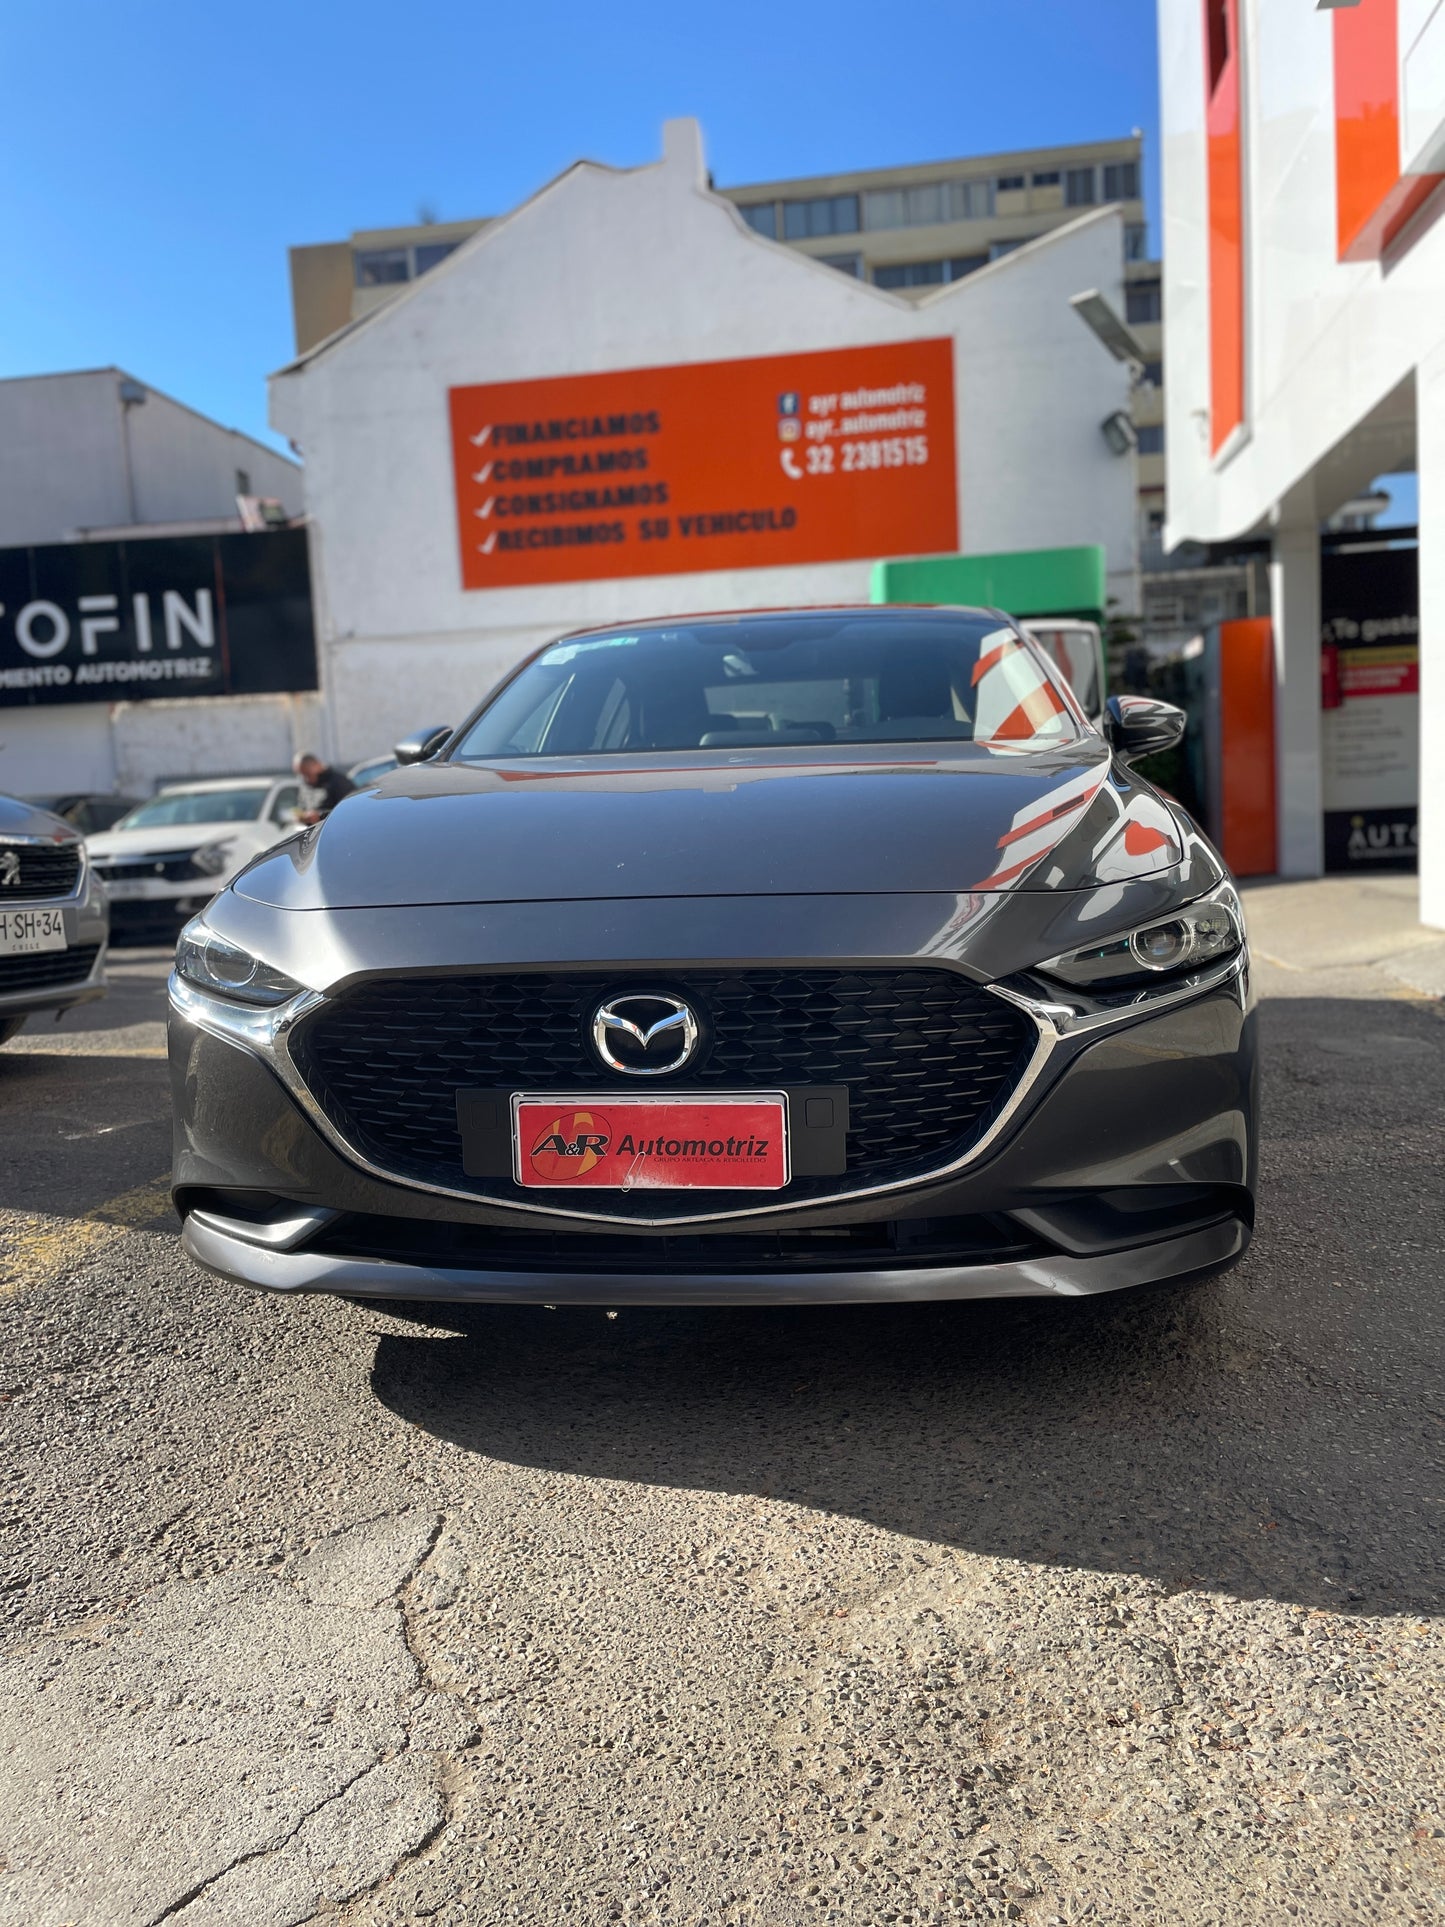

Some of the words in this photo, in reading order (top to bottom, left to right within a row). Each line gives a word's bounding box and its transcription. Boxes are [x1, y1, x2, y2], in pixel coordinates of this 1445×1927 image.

[808, 393, 837, 417] ayr
[840, 382, 925, 410] automotriz
[492, 411, 660, 447] FINANCIAMOS
[493, 449, 649, 482] COMPRAMOS
[806, 445, 834, 474] 32
[841, 435, 928, 471] 2381515
[495, 483, 668, 517] CONSIGNAMOS
[499, 521, 625, 551] RECIBIMOS
[639, 517, 670, 541] SU
[679, 506, 796, 538] VEHICULO
[0, 588, 214, 659] OFIN
[75, 656, 211, 684] AUTOMOTRIZ
[530, 1134, 610, 1156] A&R
[616, 1134, 769, 1156] Automotriz
